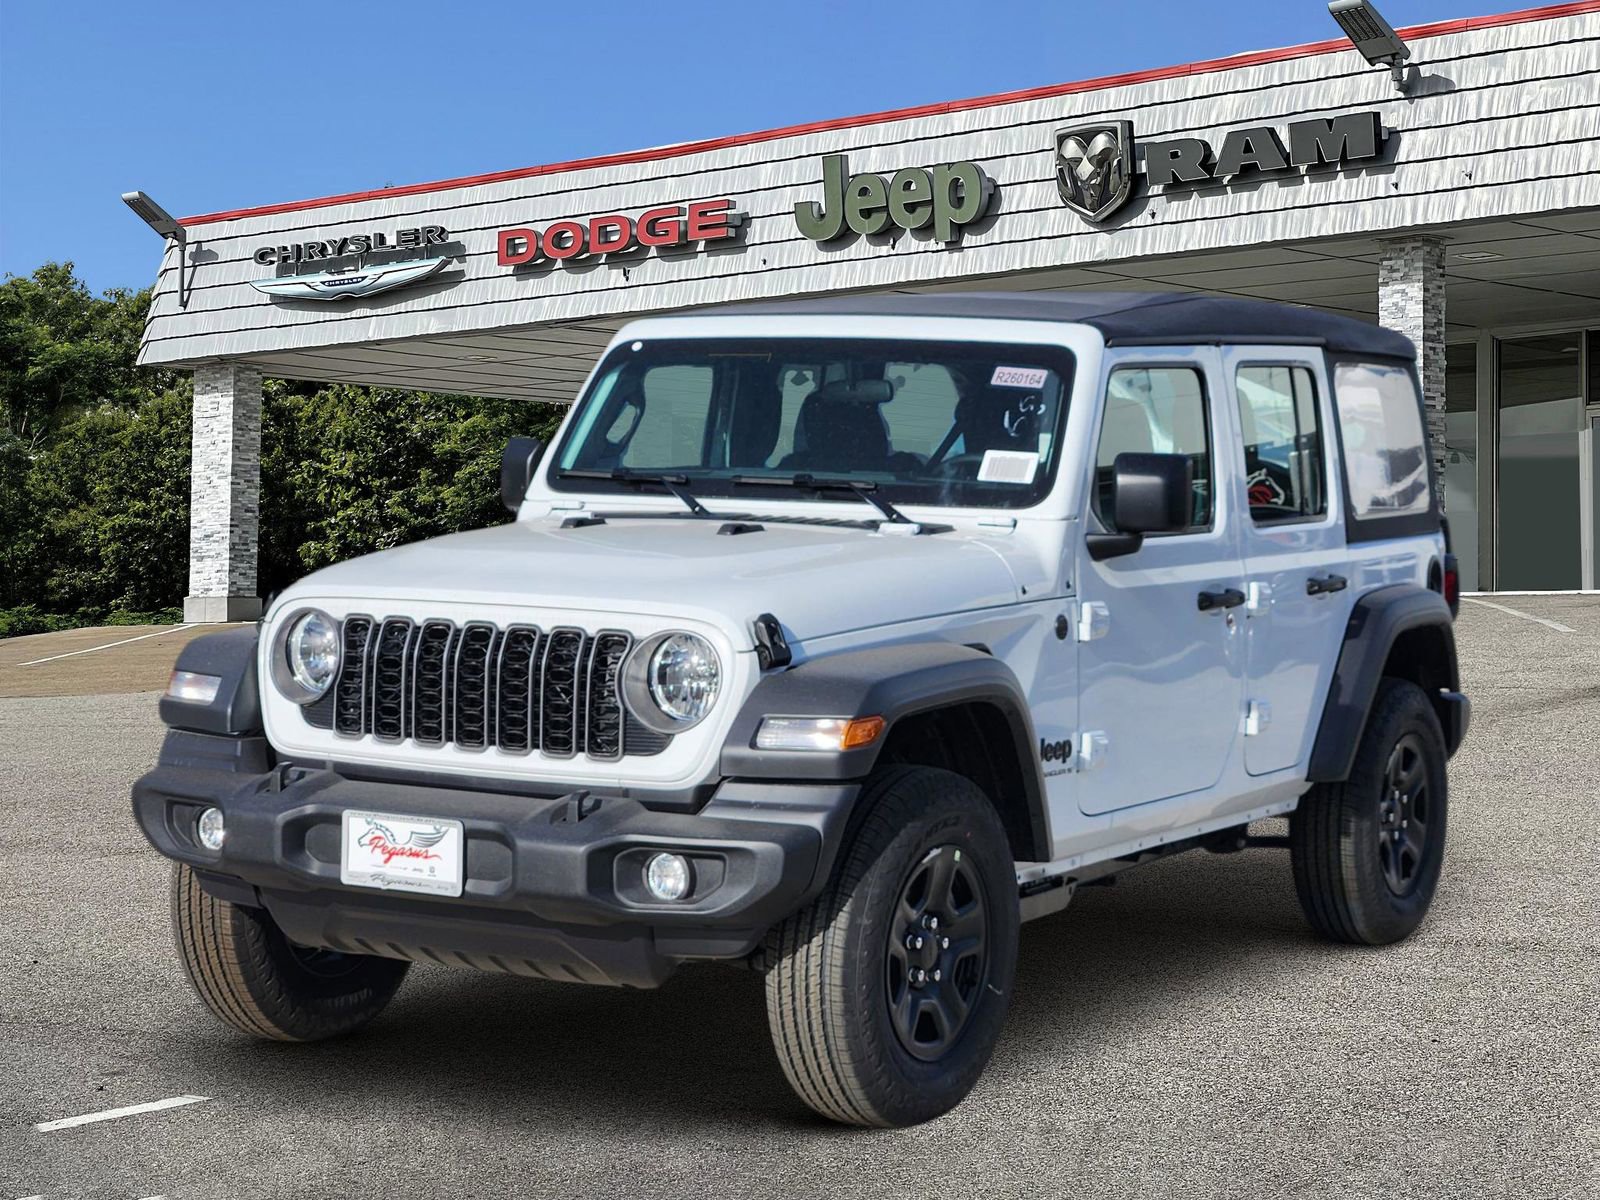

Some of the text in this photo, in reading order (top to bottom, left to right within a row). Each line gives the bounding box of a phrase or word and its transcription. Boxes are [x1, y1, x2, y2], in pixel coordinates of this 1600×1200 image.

[1144, 111, 1379, 187] RAM
[794, 154, 986, 243] Jeep
[253, 225, 447, 266] CHRYSLER
[497, 199, 733, 266] DODGE
[324, 277, 363, 286] CHRYSLER
[996, 372, 1042, 385] R260164
[369, 836, 442, 864] Pegasus
